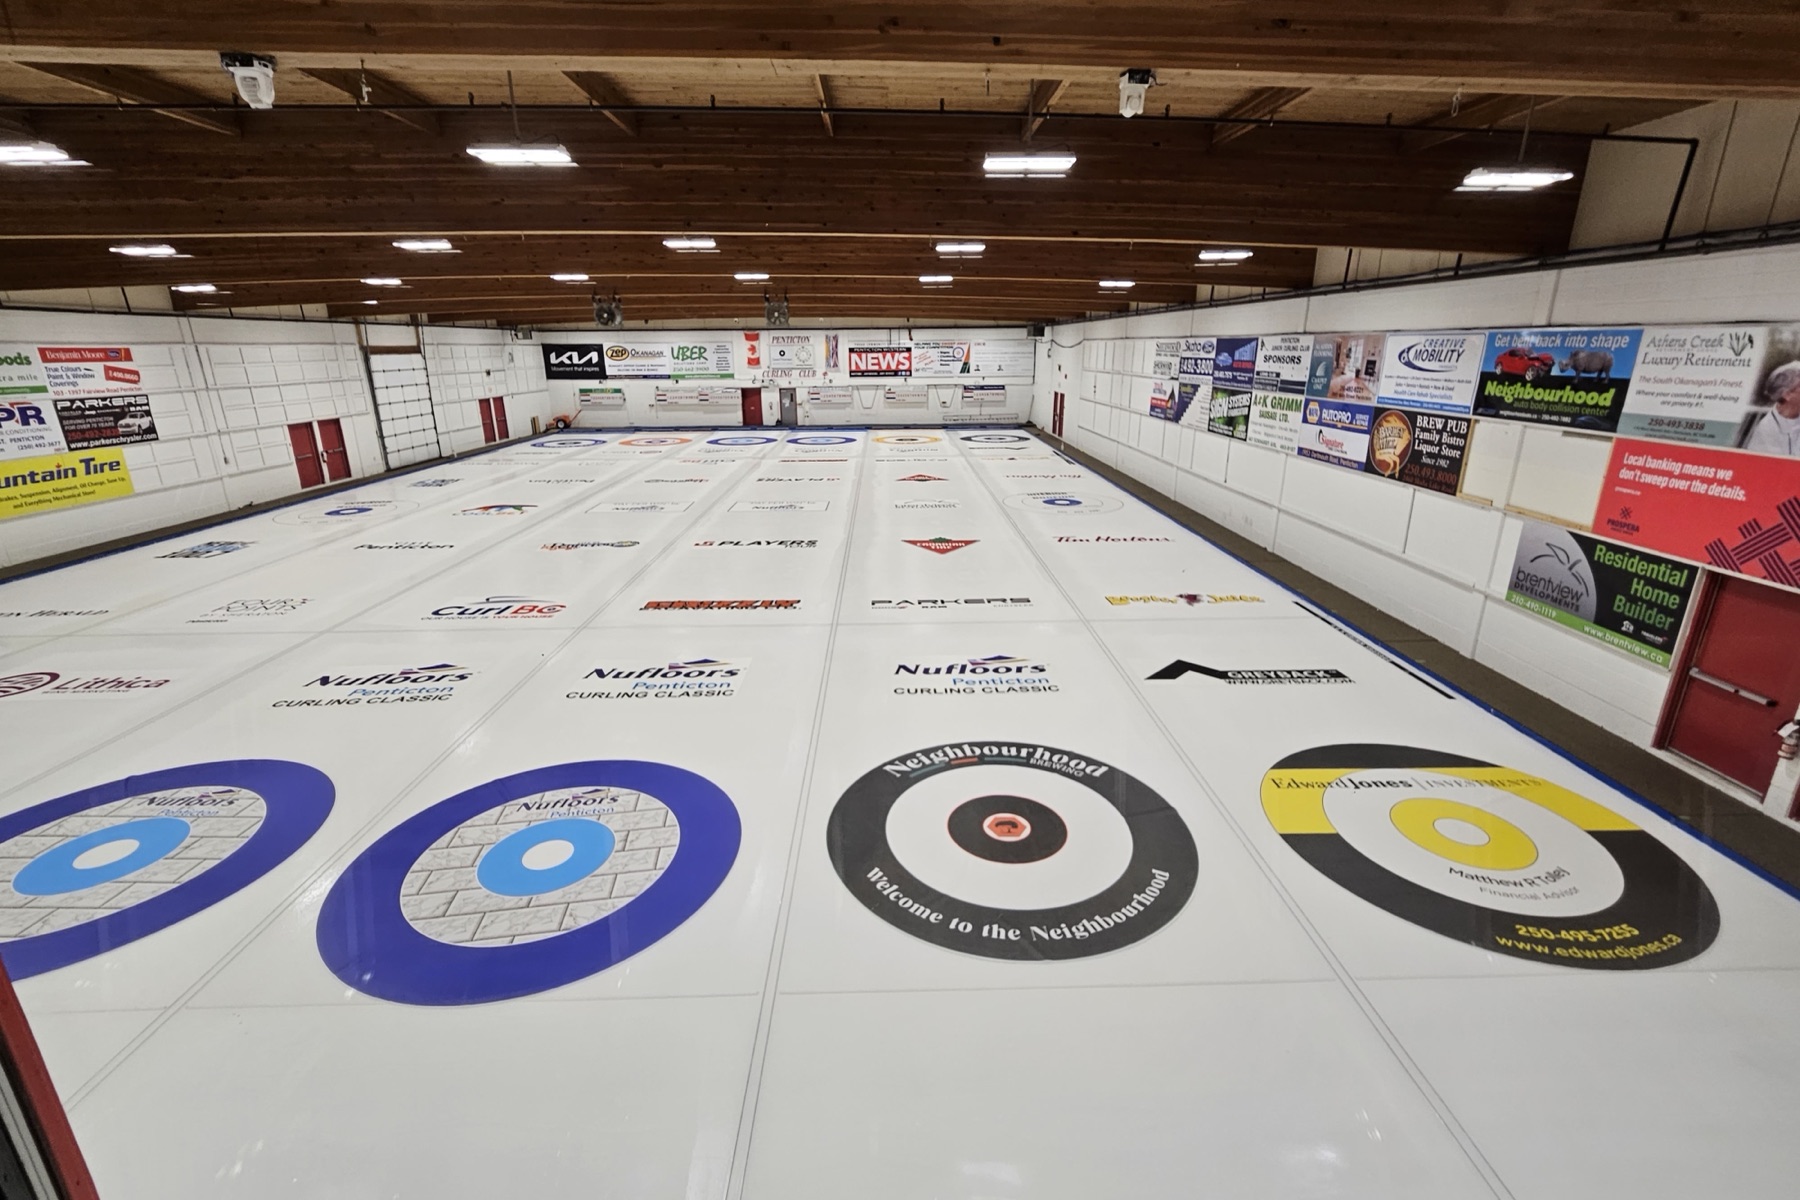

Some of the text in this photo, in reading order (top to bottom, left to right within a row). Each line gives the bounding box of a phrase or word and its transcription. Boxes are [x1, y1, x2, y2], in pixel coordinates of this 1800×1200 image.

[772, 335, 812, 345] PENTICTON
[1423, 338, 1467, 349] CREATIVE
[1495, 333, 1511, 347] Get
[1536, 333, 1561, 348] back
[1565, 333, 1587, 348] into
[1590, 333, 1629, 351] shape
[1646, 333, 1725, 348] Athens Creek
[45, 351, 106, 361] Benjamin Moore
[671, 345, 709, 361] UBER
[1263, 354, 1303, 365] SPONSORS
[1412, 349, 1466, 363] MOBILITY
[850, 353, 911, 371] NEWS
[1641, 352, 1752, 370] Luxury Retirement
[18, 373, 39, 382] mile
[47, 373, 65, 381] Paint
[72, 372, 96, 380] Window
[762, 370, 817, 378] CURLING CLUB
[1639, 375, 1651, 383] The
[1652, 376, 1673, 385] South
[1674, 377, 1718, 388] Okanagan's
[50, 380, 79, 389] Coverings
[1484, 380, 1616, 407] Neighbourhood
[57, 395, 149, 410] PARKERS
[1271, 396, 1303, 413] GRIMM
[1513, 400, 1610, 417] auto body collision center
[1322, 408, 1352, 424] AUTOPRO
[5, 427, 53, 437] CONDITIONING
[1416, 415, 1469, 434] BREW PUB
[10, 435, 46, 444] PENTICTON
[69, 433, 157, 450] www.parkerschrysler.com
[1415, 428, 1465, 447] Family Bistro
[1414, 439, 1462, 459] Liquor Store
[0, 457, 121, 489] untain Tire
[1623, 452, 1734, 481] Local banking means we
[1619, 467, 1746, 502] don't sweep over the details.
[1607, 518, 1640, 533] PROSPERA
[717, 539, 818, 547] PLAYERS
[1594, 544, 1689, 588] Residential
[1515, 566, 1584, 602] brentview
[1514, 582, 1580, 613] DEVELOPMENTS
[1630, 577, 1681, 610] Home
[871, 597, 1031, 606] PARKERS
[1613, 594, 1674, 631] Builder
[1583, 624, 1663, 664] www.brentview.ca
[583, 667, 742, 680] Nufloors
[894, 663, 1047, 675] Nufloors
[1227, 669, 1331, 679] GREYBACK
[51, 676, 171, 691] Lithica
[302, 672, 474, 688] Nufloors
[632, 680, 733, 691] Penticton
[952, 677, 1051, 686] Penticton
[348, 686, 455, 697] Penticton
[566, 689, 735, 700] CURLING CLASSIC
[893, 685, 1060, 696] CURLING CLASSIC
[272, 693, 454, 708] CURLING CLASSIC
[883, 743, 1109, 778] Neighbourhood
[1029, 757, 1085, 778] BREWING
[137, 796, 240, 807] Nufloors
[516, 796, 620, 813] Nufloors
[550, 807, 614, 818] Penticton
[1448, 866, 1524, 888] Matthew
[1479, 886, 1543, 901] Financial
[866, 866, 1171, 942] Welcome to the Neighbourhood
[1515, 923, 1640, 943] 250-495-7255
[1495, 933, 1683, 960] www.edwardjones.ca
